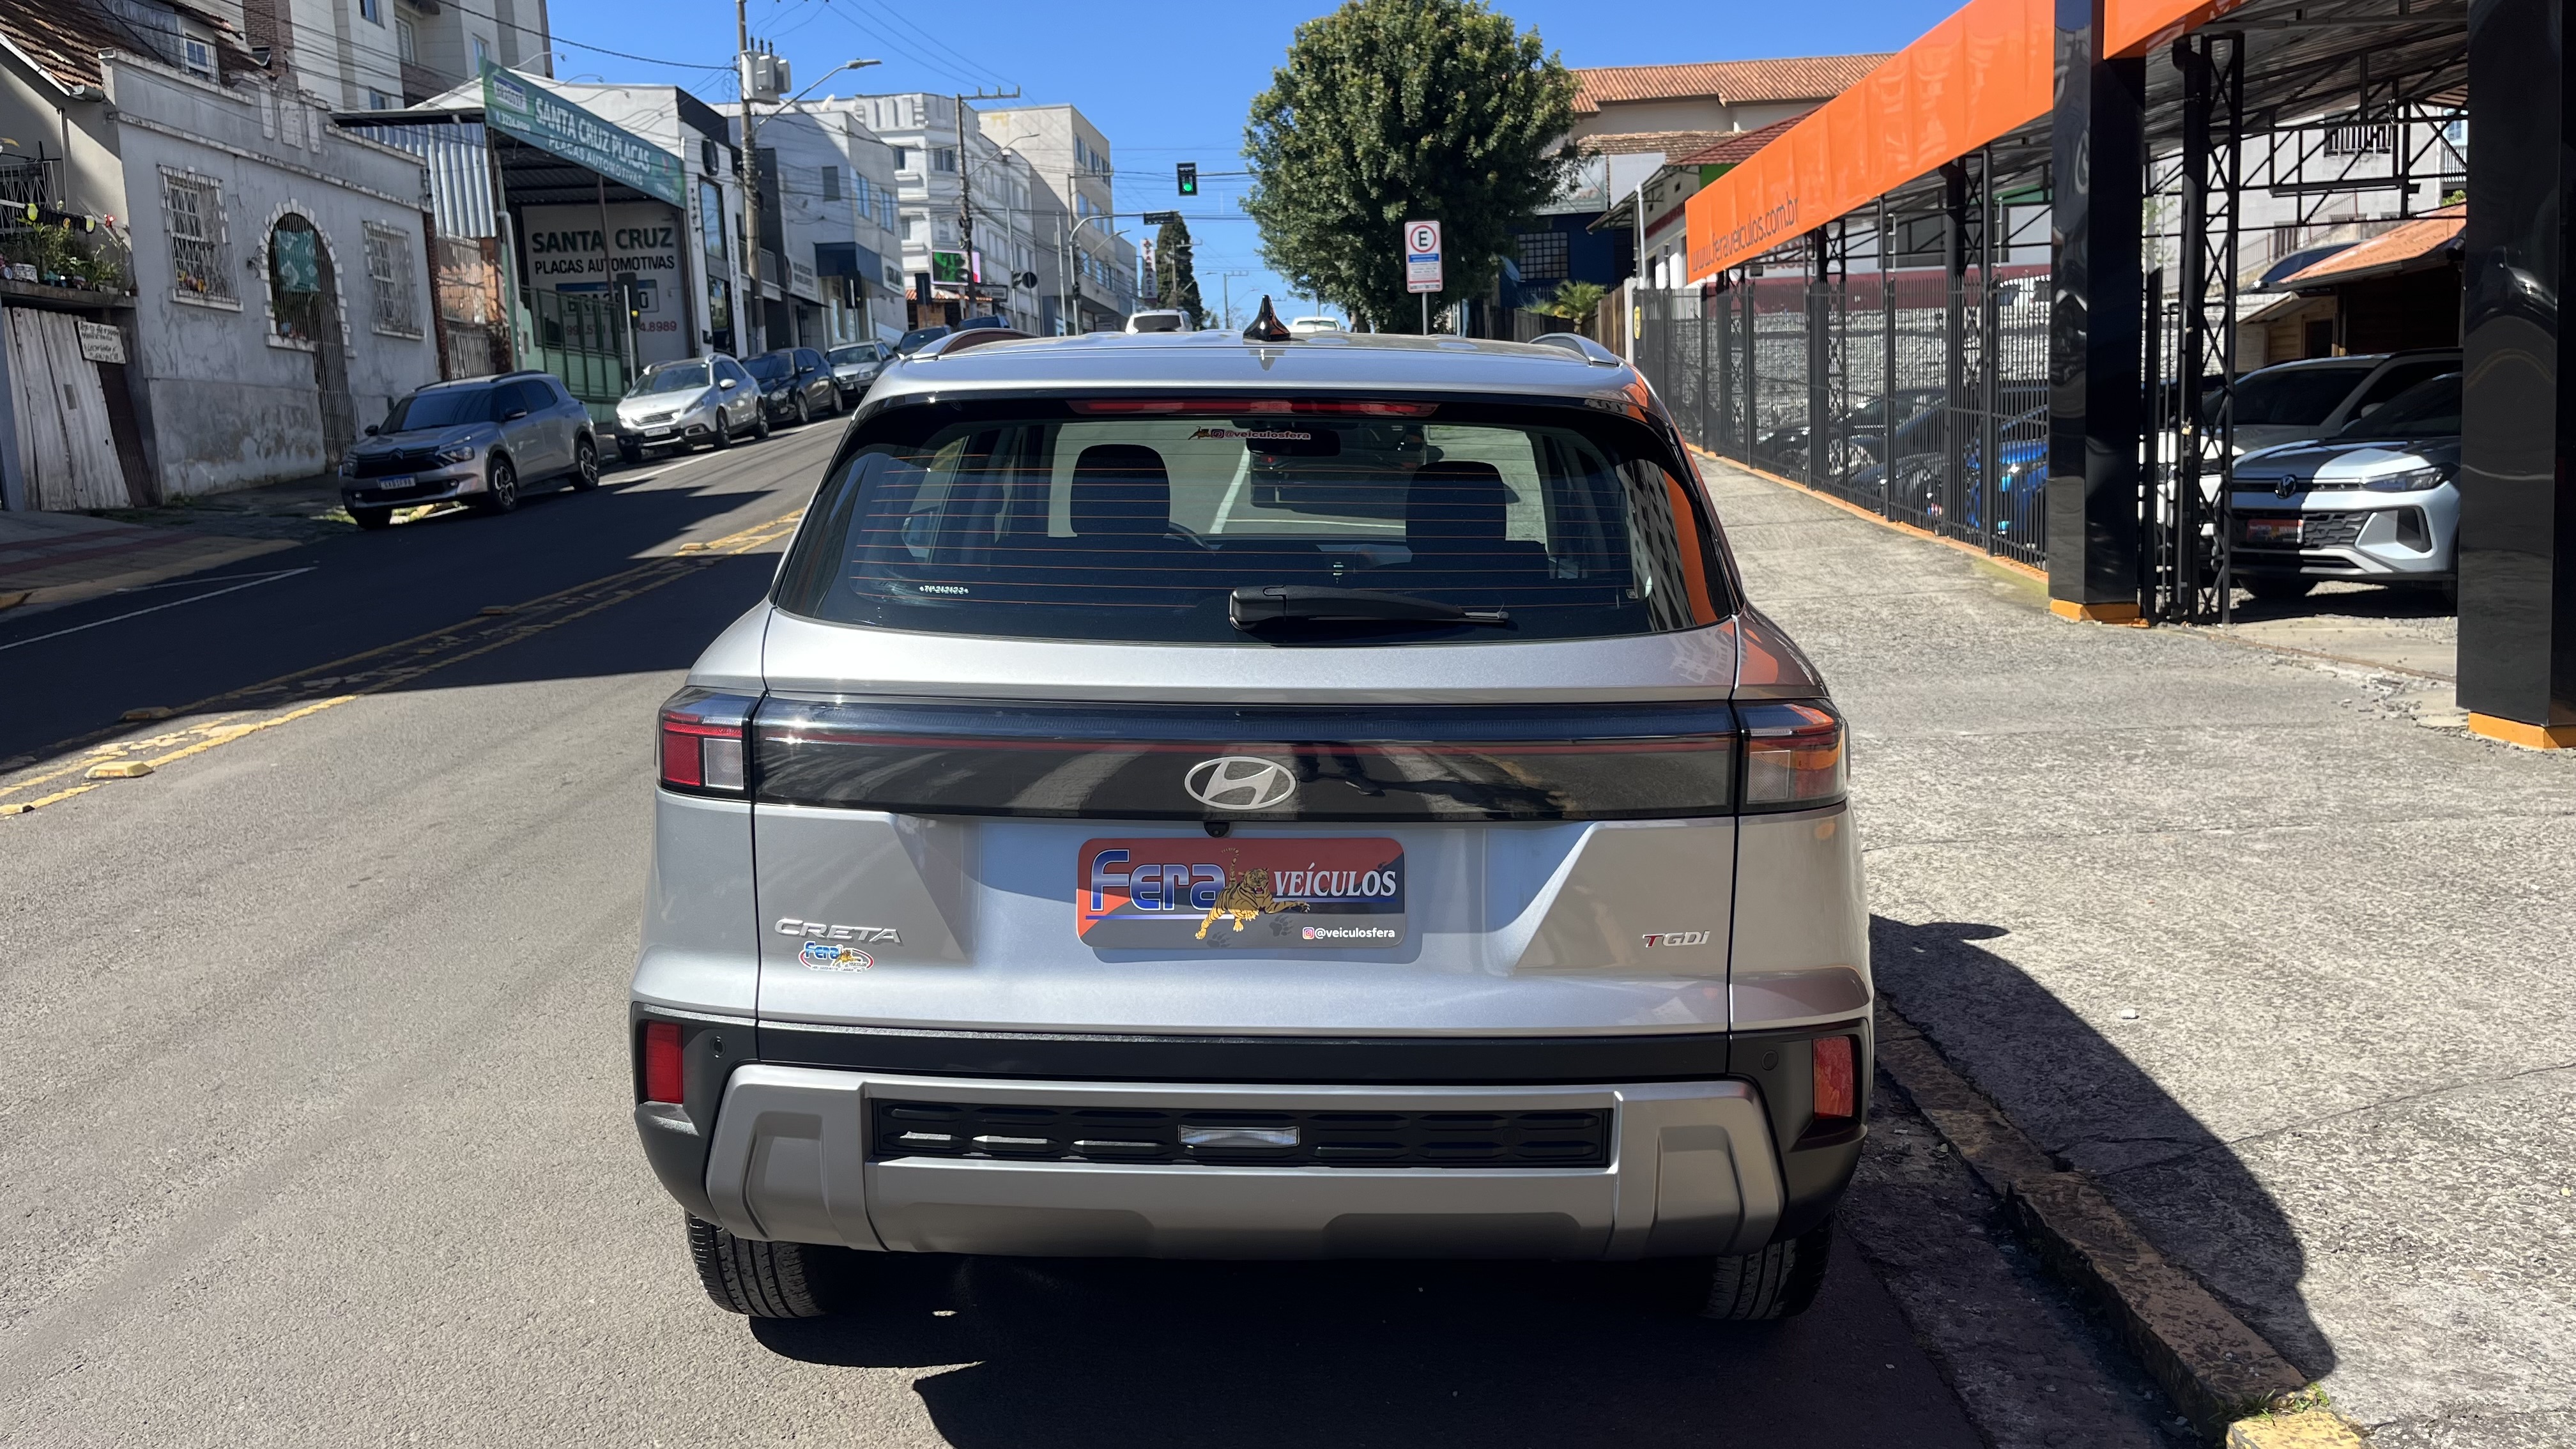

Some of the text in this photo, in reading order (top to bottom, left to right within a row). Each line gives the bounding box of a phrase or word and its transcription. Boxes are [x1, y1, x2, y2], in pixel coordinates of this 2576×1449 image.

[535, 97, 650, 174] SANTA CRUZ PLACAS
[549, 135, 643, 186] PLACAS AUTOMOTIVAS
[532, 227, 674, 254] SANTA CRUZ
[1419, 231, 1428, 247] E
[1691, 191, 1798, 272] www.feraveiculos.com.br
[535, 256, 675, 275] PLACAS AUTOMOTIVAS
[1225, 430, 1310, 440] @veiculosfera
[1274, 863, 1396, 898] VEÍCULOS
[775, 918, 901, 943] CRETA
[1315, 927, 1395, 939] @veiculosfera
